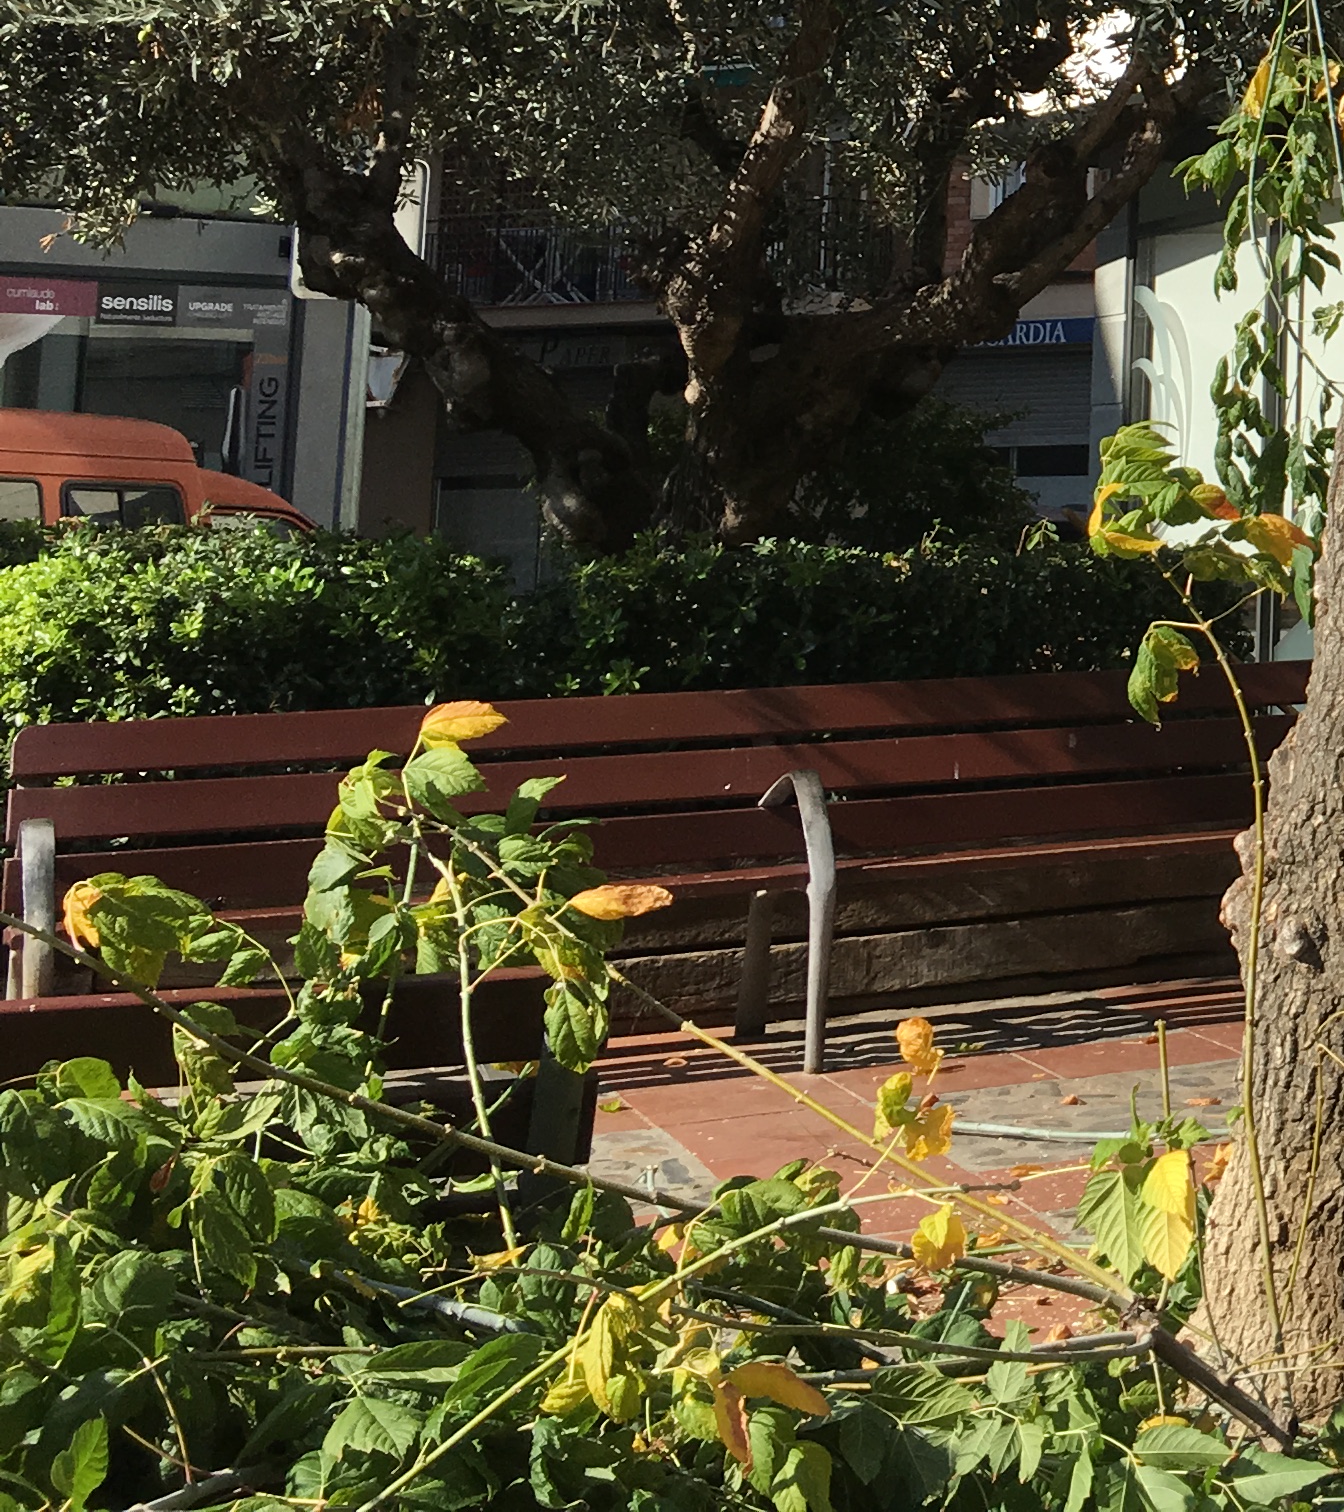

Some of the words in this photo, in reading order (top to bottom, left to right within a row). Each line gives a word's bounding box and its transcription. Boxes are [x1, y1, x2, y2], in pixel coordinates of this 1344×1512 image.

[101, 294, 174, 312] sensilis
[188, 301, 234, 312] UPGRADE
[253, 376, 280, 487] LIFTING
